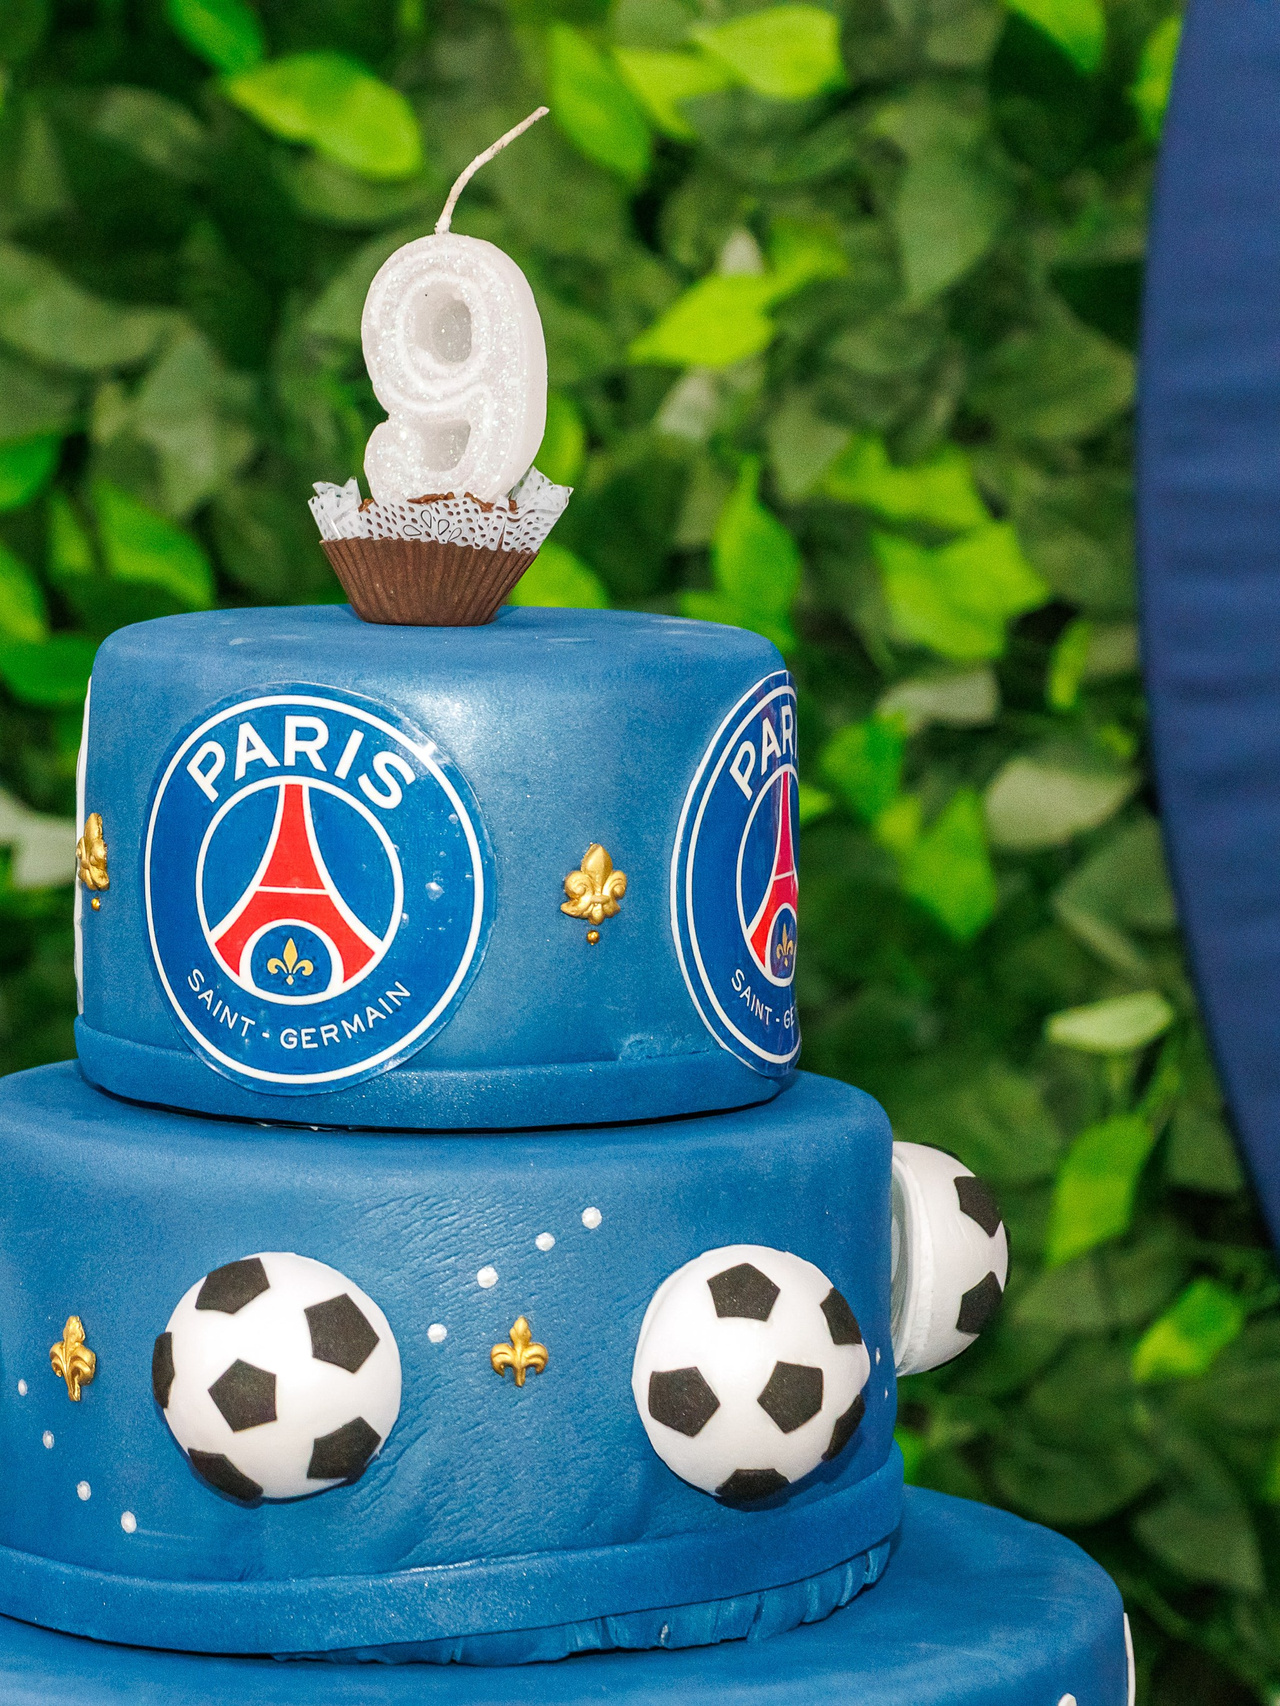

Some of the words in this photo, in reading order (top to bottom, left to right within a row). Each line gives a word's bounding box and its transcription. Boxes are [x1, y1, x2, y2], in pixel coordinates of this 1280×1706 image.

[362, 234, 548, 501] 9
[186, 715, 416, 809] PARIS
[187, 968, 255, 1037] SAINT
[280, 981, 411, 1049] GERMAIN
[731, 968, 773, 1026] SAINT
